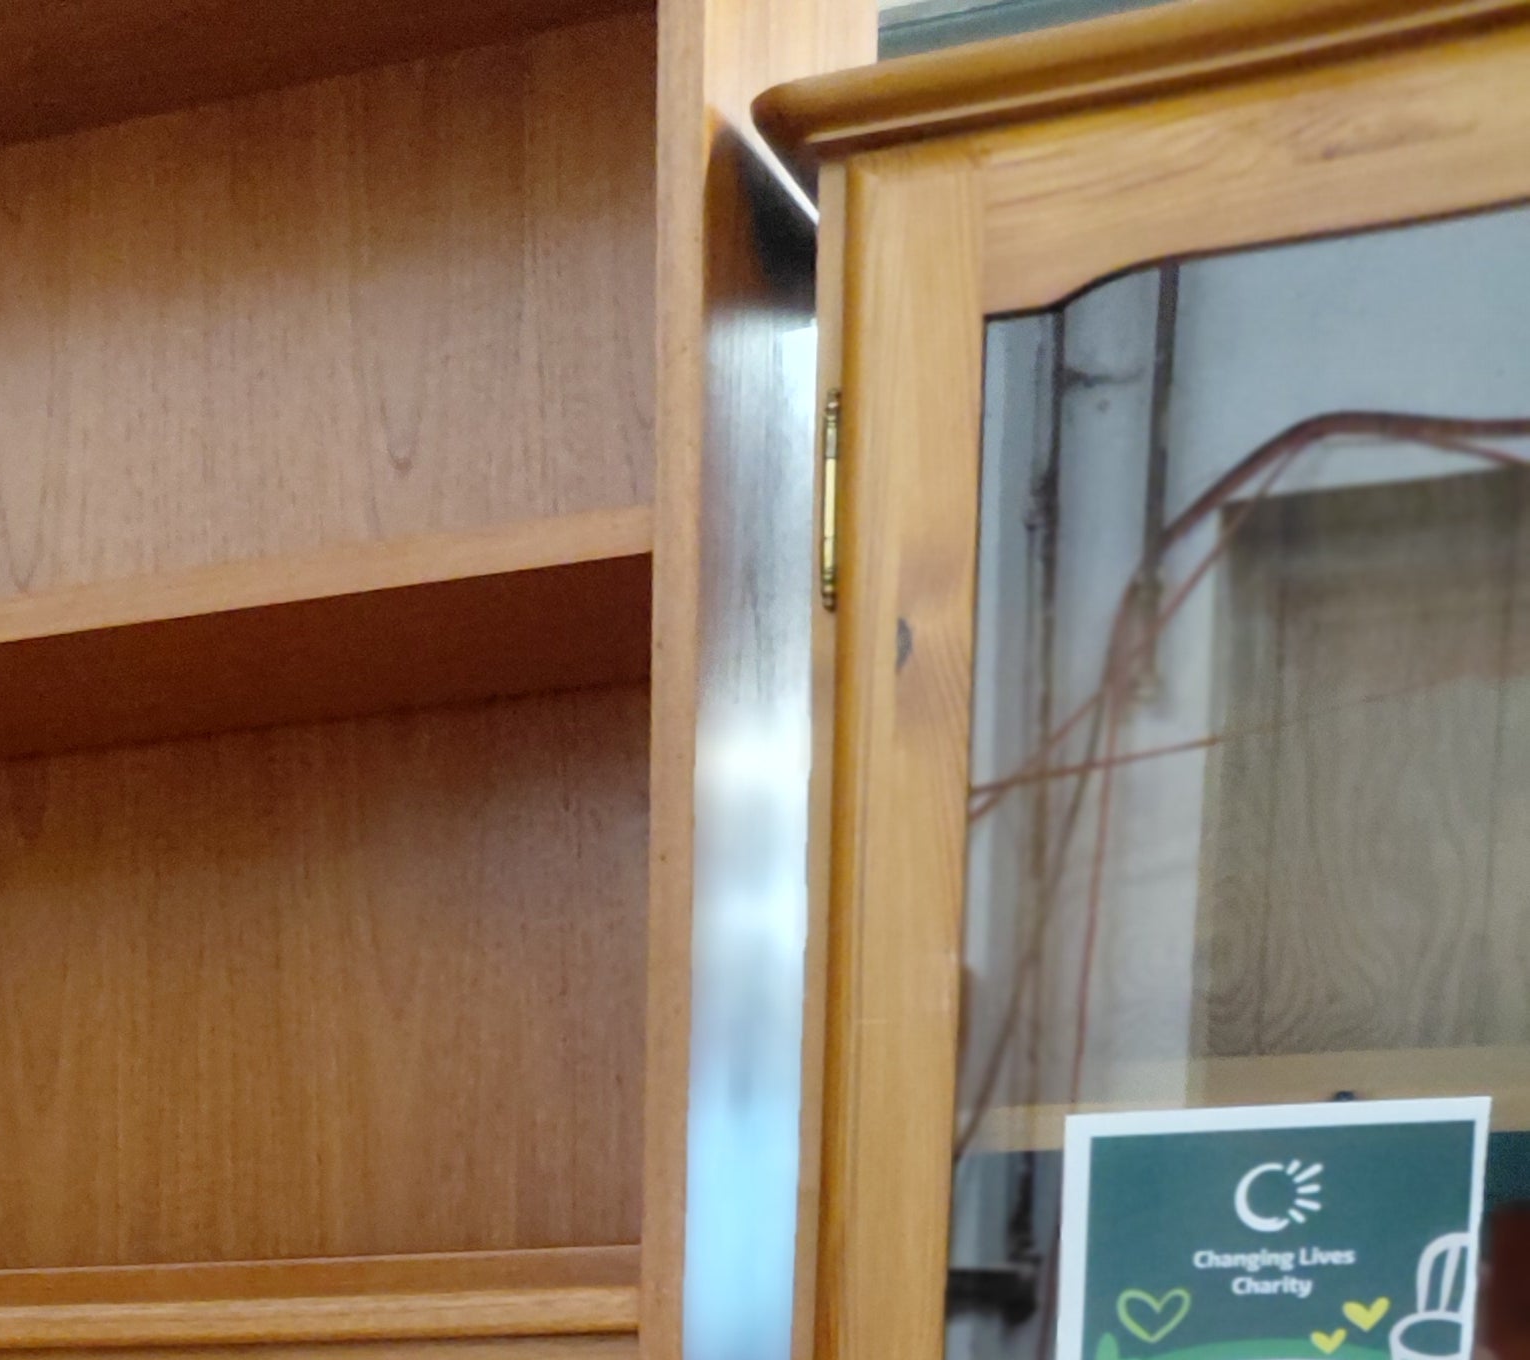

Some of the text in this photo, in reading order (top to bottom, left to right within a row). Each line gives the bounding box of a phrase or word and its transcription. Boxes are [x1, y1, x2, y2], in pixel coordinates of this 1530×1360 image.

[1192, 1246, 1357, 1272] Changing Lives
[1231, 1275, 1313, 1299] Charity
